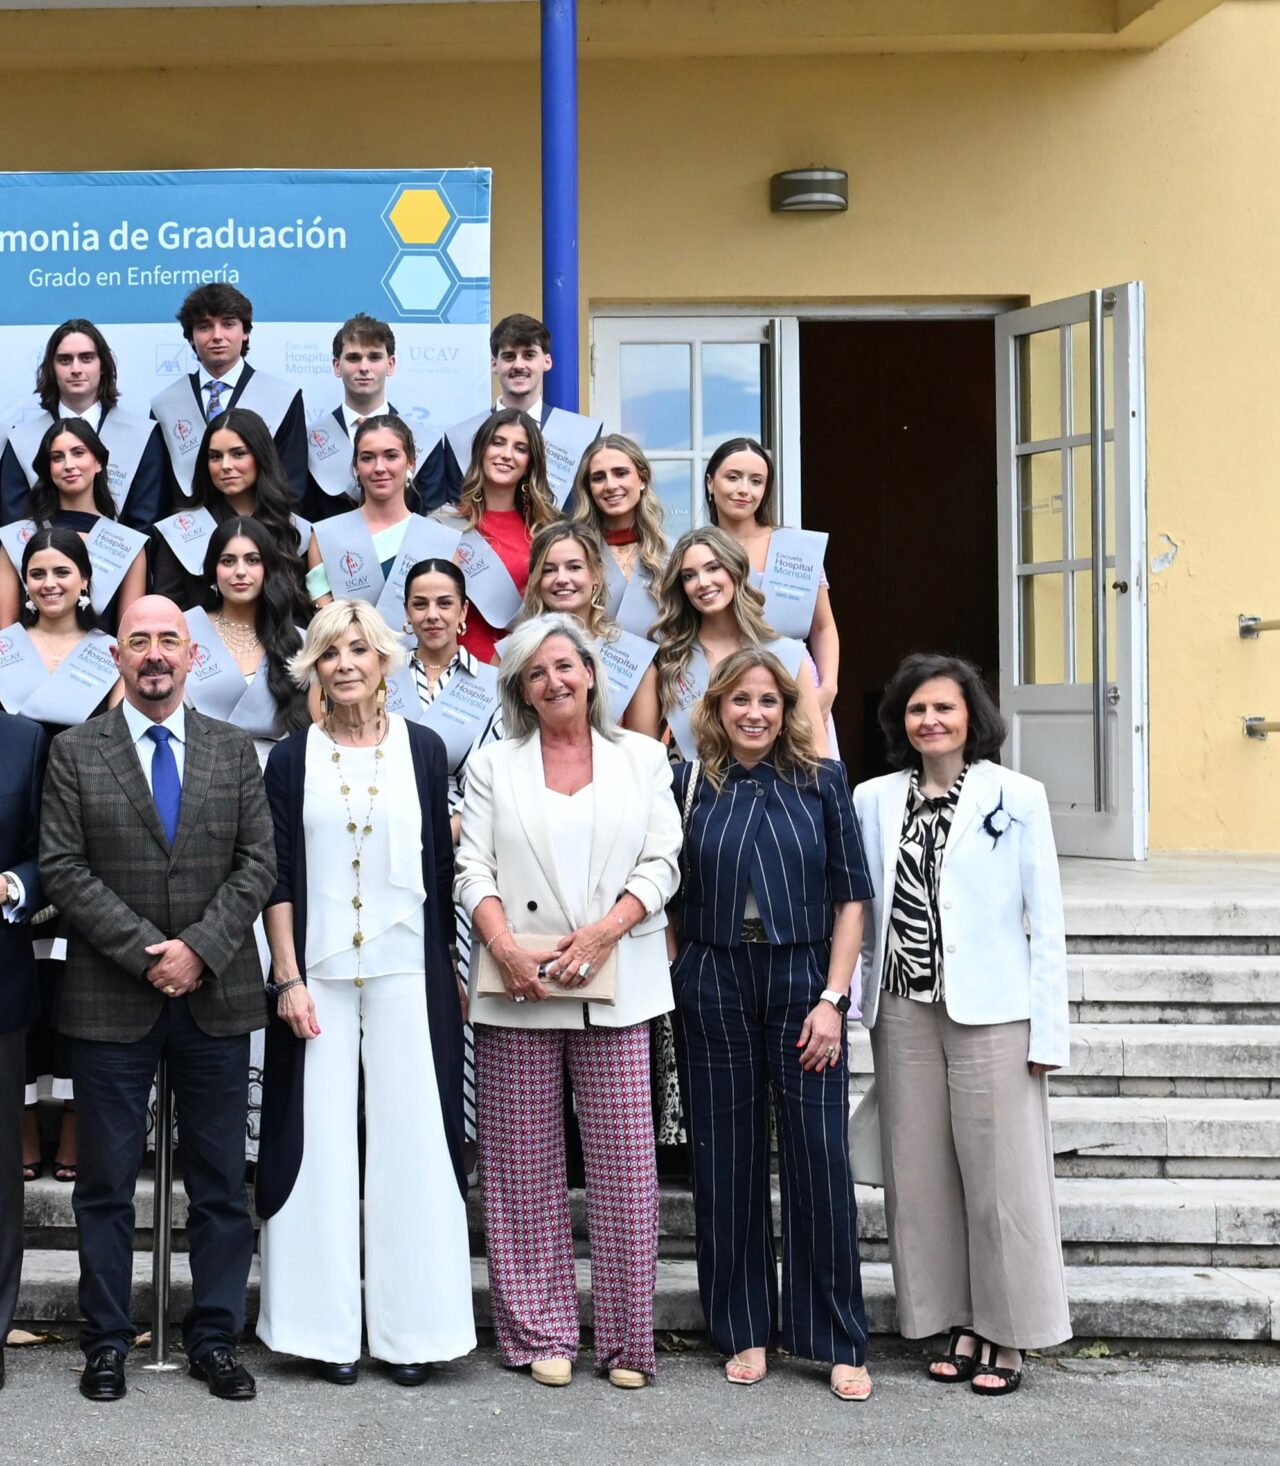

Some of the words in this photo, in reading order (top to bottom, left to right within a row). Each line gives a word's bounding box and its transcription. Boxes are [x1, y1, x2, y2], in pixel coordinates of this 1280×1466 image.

[109, 220, 149, 251] de
[158, 215, 346, 250] Graduación
[28, 266, 91, 287] Grado
[96, 271, 121, 286] en
[127, 263, 240, 285] Enfermería
[409, 346, 459, 361] UCAV
[178, 437, 198, 450] UCAV
[316, 443, 337, 457] UCAV
[181, 527, 203, 539] UCAV
[97, 533, 133, 553] Hospital
[464, 559, 485, 574] UCAV
[775, 558, 814, 573] Hospital
[773, 566, 811, 581] Mompía
[345, 576, 368, 587] UCAV
[83, 648, 116, 669] Hospita
[600, 647, 639, 672] Hospital
[195, 663, 219, 677] UCAV
[455, 683, 494, 704] Hospital
